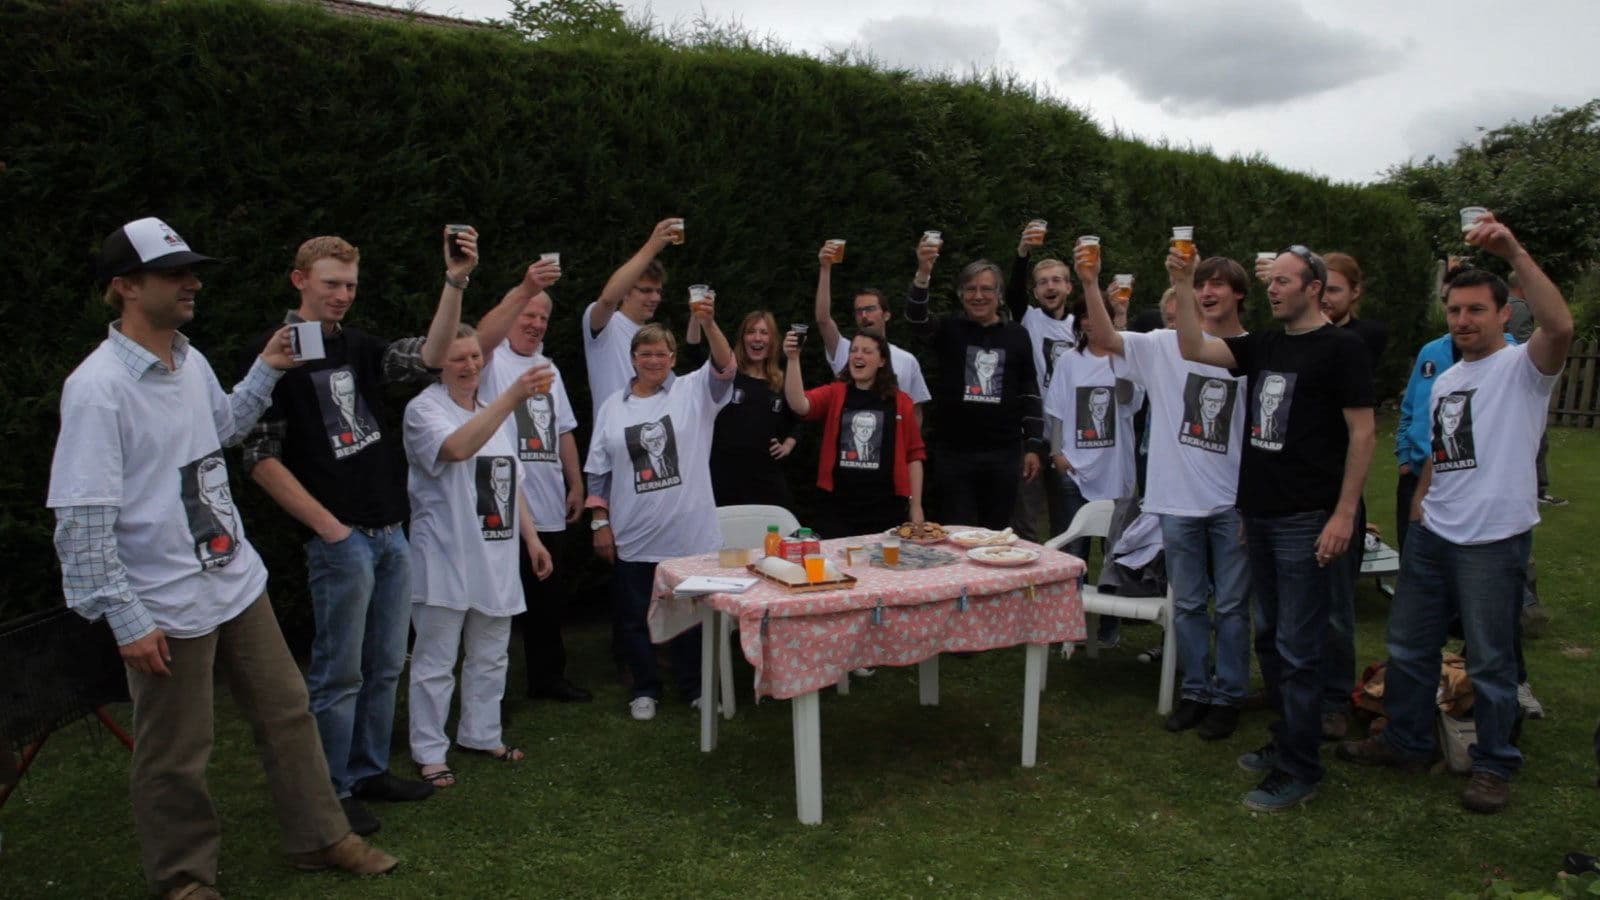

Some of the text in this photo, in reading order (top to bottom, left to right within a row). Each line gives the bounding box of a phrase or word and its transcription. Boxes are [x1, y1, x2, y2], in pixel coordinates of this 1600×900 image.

[1181, 421, 1190, 434] I
[332, 435, 342, 448] I
[521, 437, 528, 450] I
[1077, 439, 1114, 448] BERNARD
[1180, 434, 1227, 453] BERNARD
[839, 460, 880, 470] BERNARD
[637, 475, 681, 492] BERNARD
